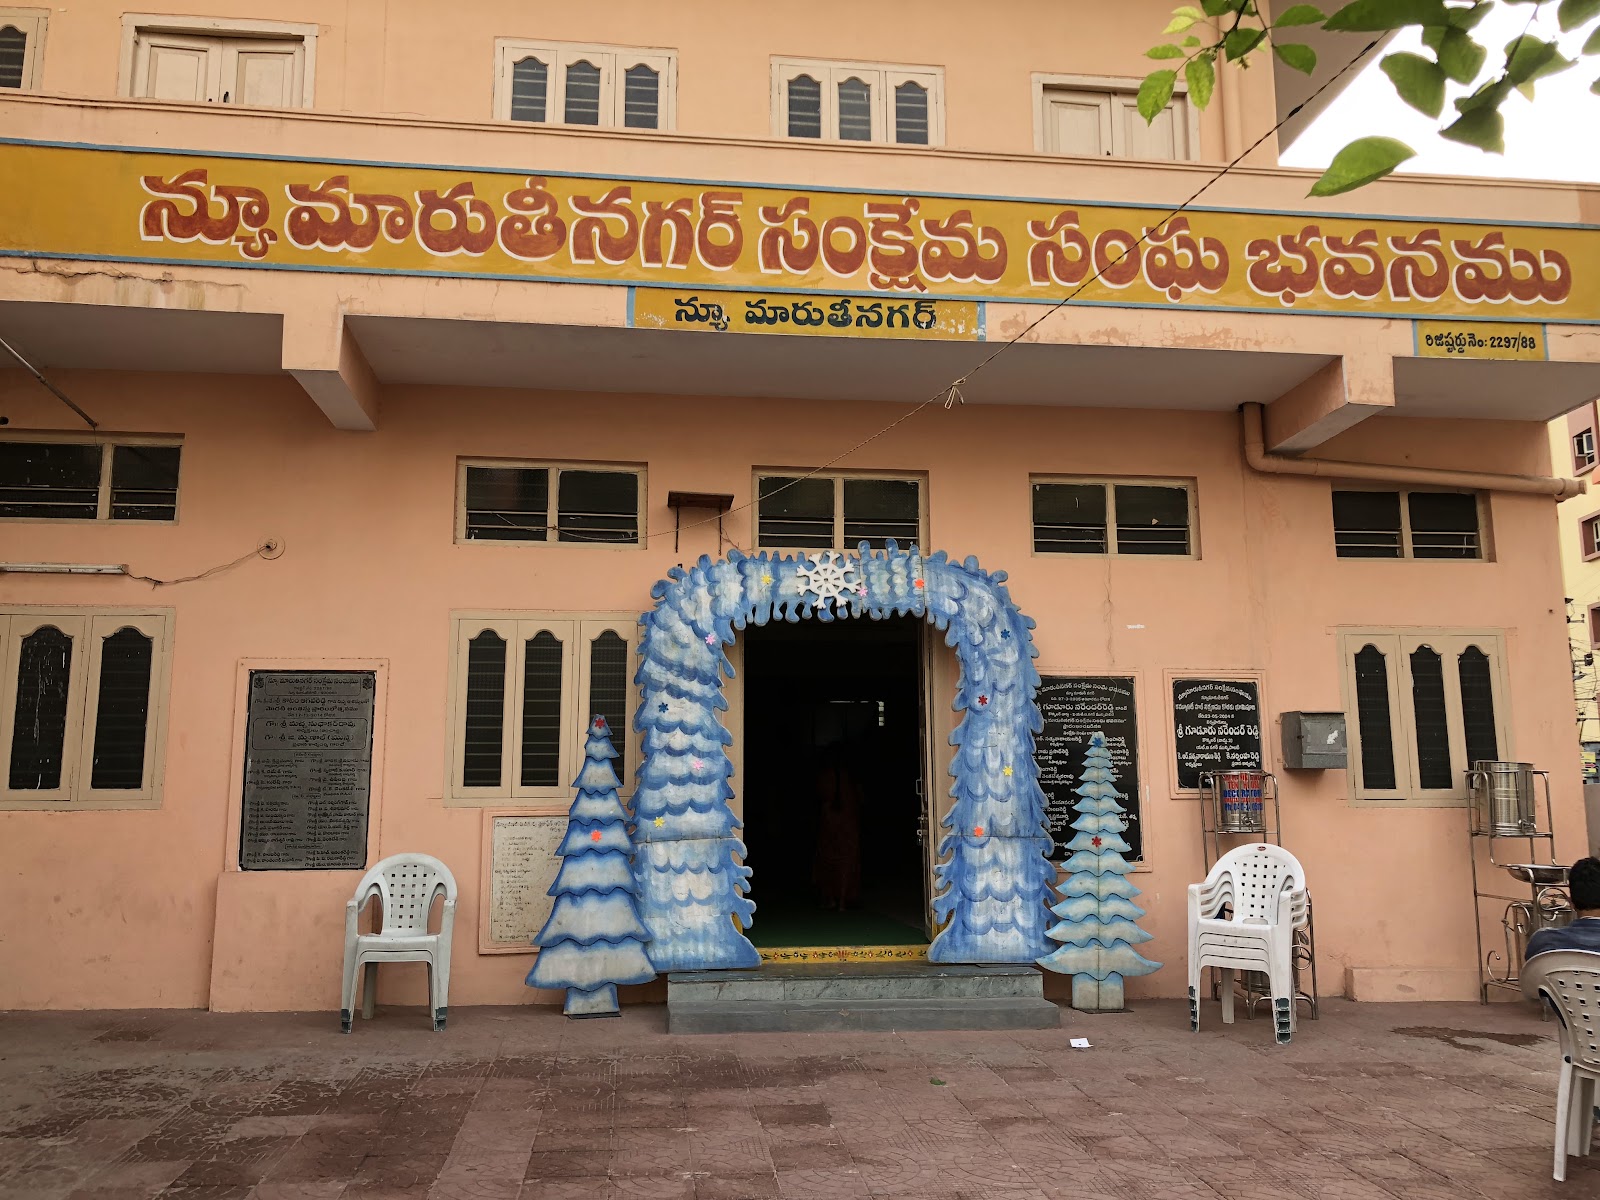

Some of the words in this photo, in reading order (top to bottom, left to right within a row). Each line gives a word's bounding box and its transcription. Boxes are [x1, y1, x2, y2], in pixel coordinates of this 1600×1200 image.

[140, 168, 278, 261] న్యూ
[284, 175, 744, 270] మారుతీనగర్
[758, 195, 1008, 293] సంక్షేమ
[1027, 209, 1230, 303] సంఘ
[1244, 224, 1573, 307] భవనము
[1489, 331, 1537, 353] 2297/88
